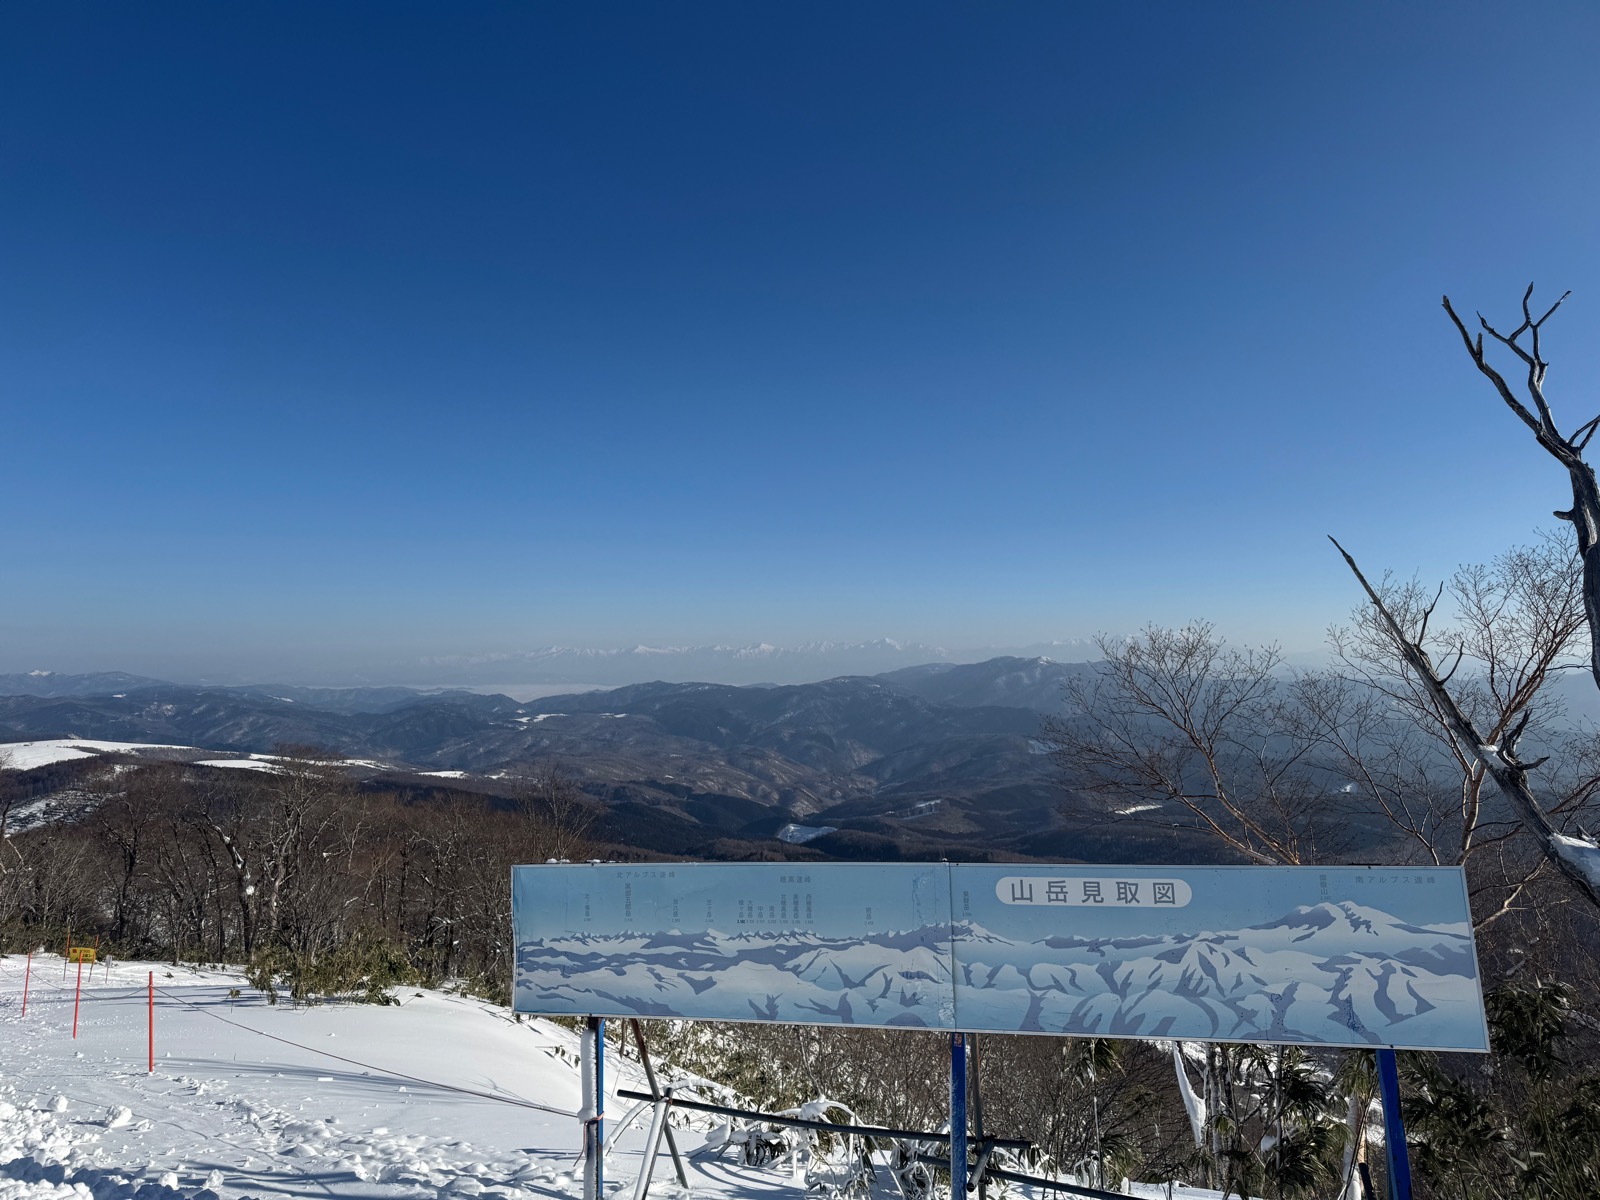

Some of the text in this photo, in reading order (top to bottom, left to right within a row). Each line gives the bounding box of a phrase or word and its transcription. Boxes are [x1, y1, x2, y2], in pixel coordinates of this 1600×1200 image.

[1355, 875, 1436, 885] 南アルプス連峰
[1011, 880, 1176, 904] 山岳見取図
